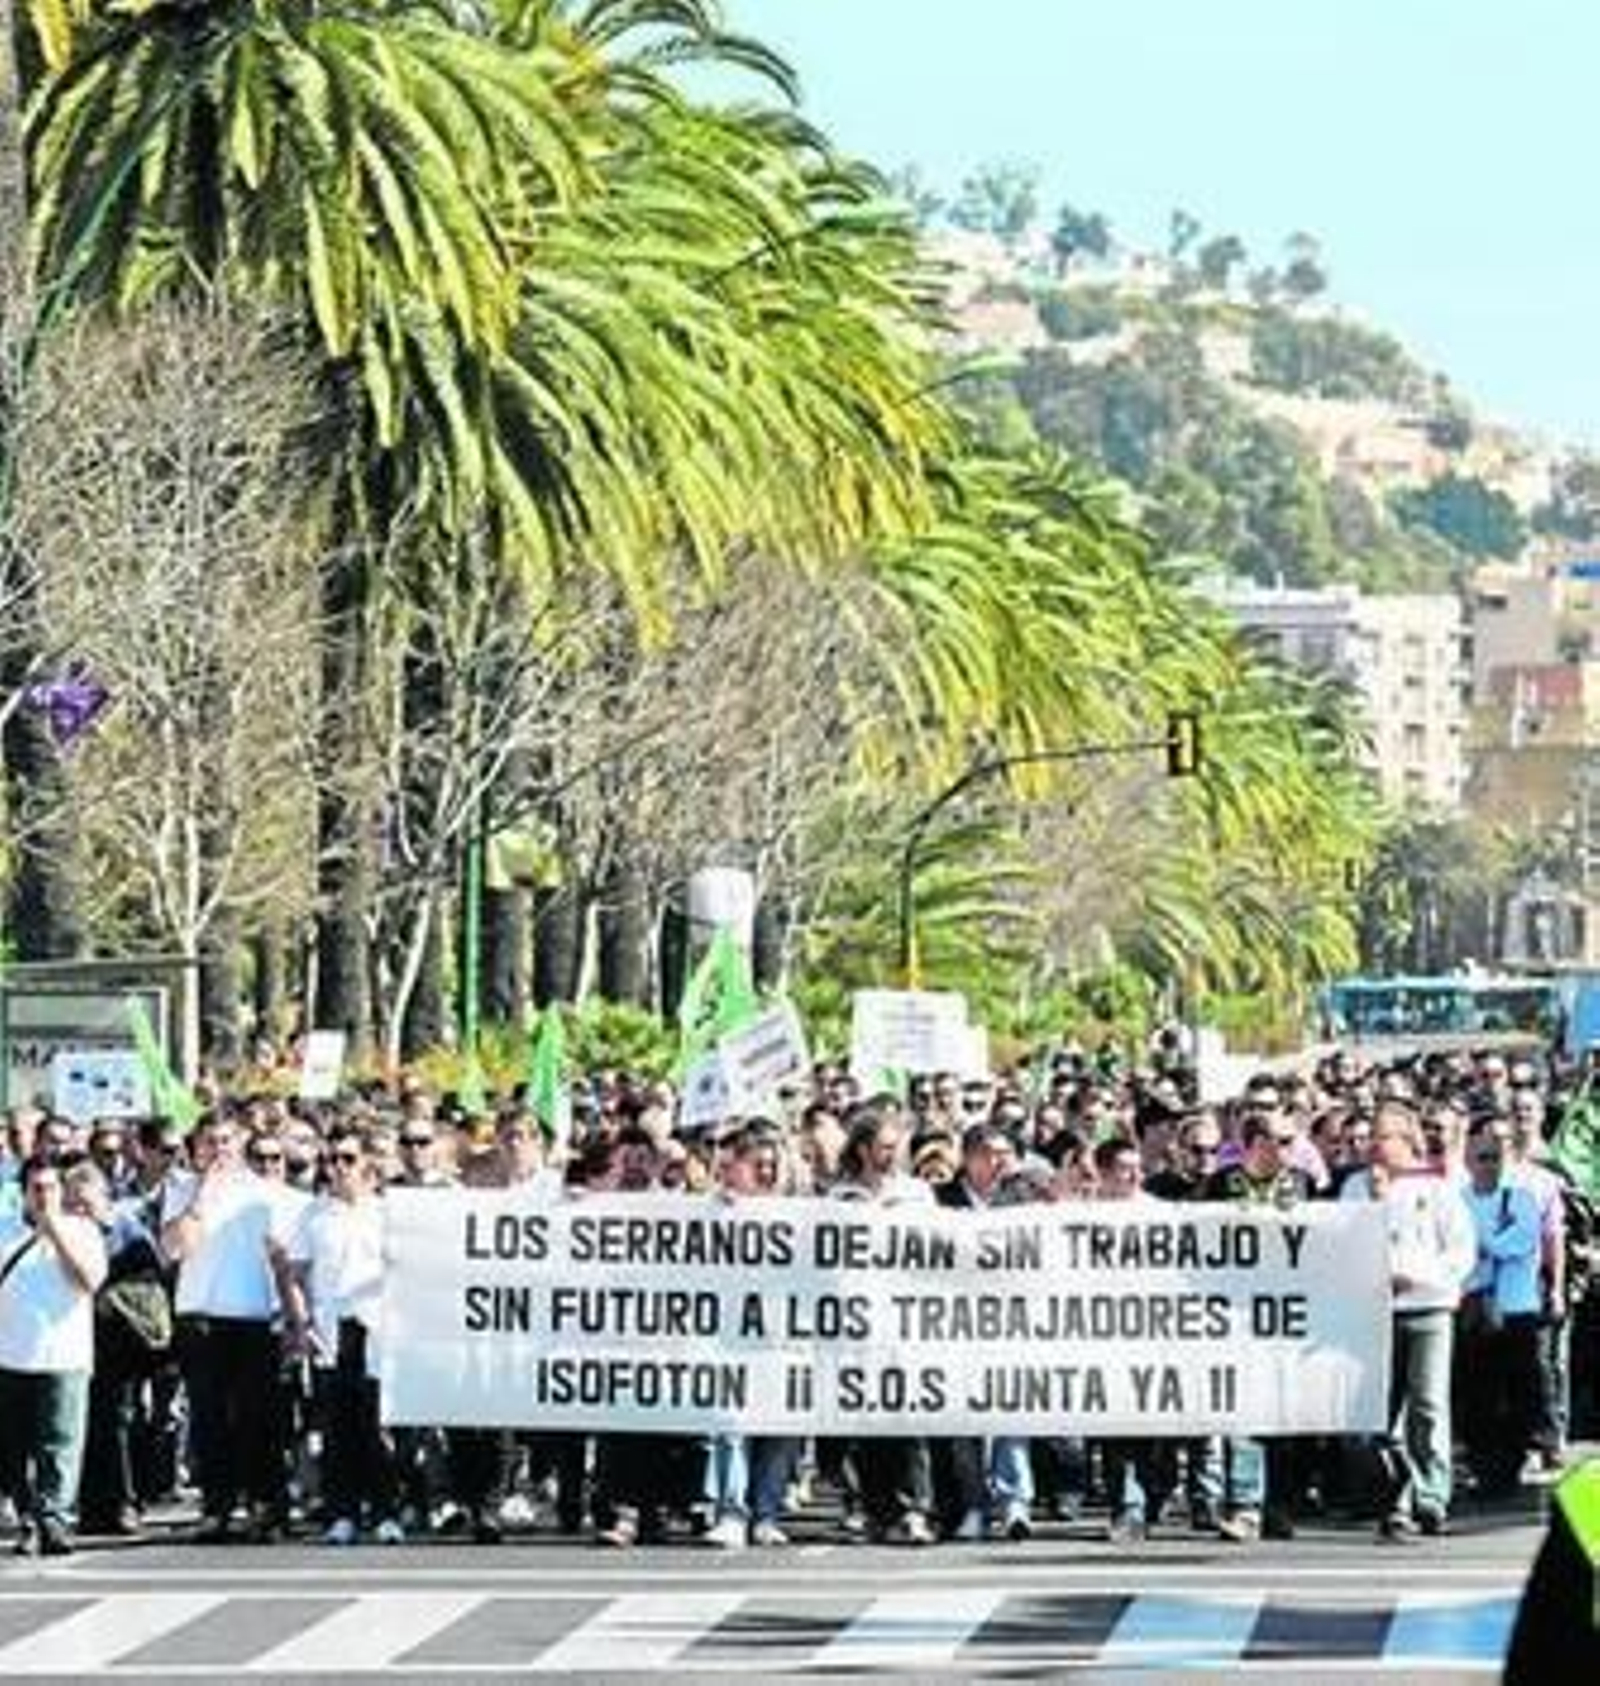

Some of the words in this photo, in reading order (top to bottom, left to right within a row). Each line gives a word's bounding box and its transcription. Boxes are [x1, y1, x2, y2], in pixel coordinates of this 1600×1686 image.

[465, 1213, 549, 1259] LOS
[570, 1217, 794, 1265] SERRANOS
[815, 1224, 954, 1269] DEJAN
[976, 1225, 1041, 1269] SIN
[1062, 1224, 1260, 1269] TRABAJO
[1282, 1224, 1307, 1269] Y
[465, 1287, 530, 1331] SIN
[552, 1288, 720, 1336] FUTURO
[740, 1293, 765, 1337] A
[787, 1295, 870, 1340] LOS
[891, 1296, 1231, 1340] TRABAJADORES
[1253, 1296, 1308, 1338] DE
[536, 1359, 747, 1408] ISOFOTON
[838, 1368, 946, 1412] S.O.S
[967, 1367, 1107, 1413] JUNTA
[1130, 1367, 1184, 1413] YA
